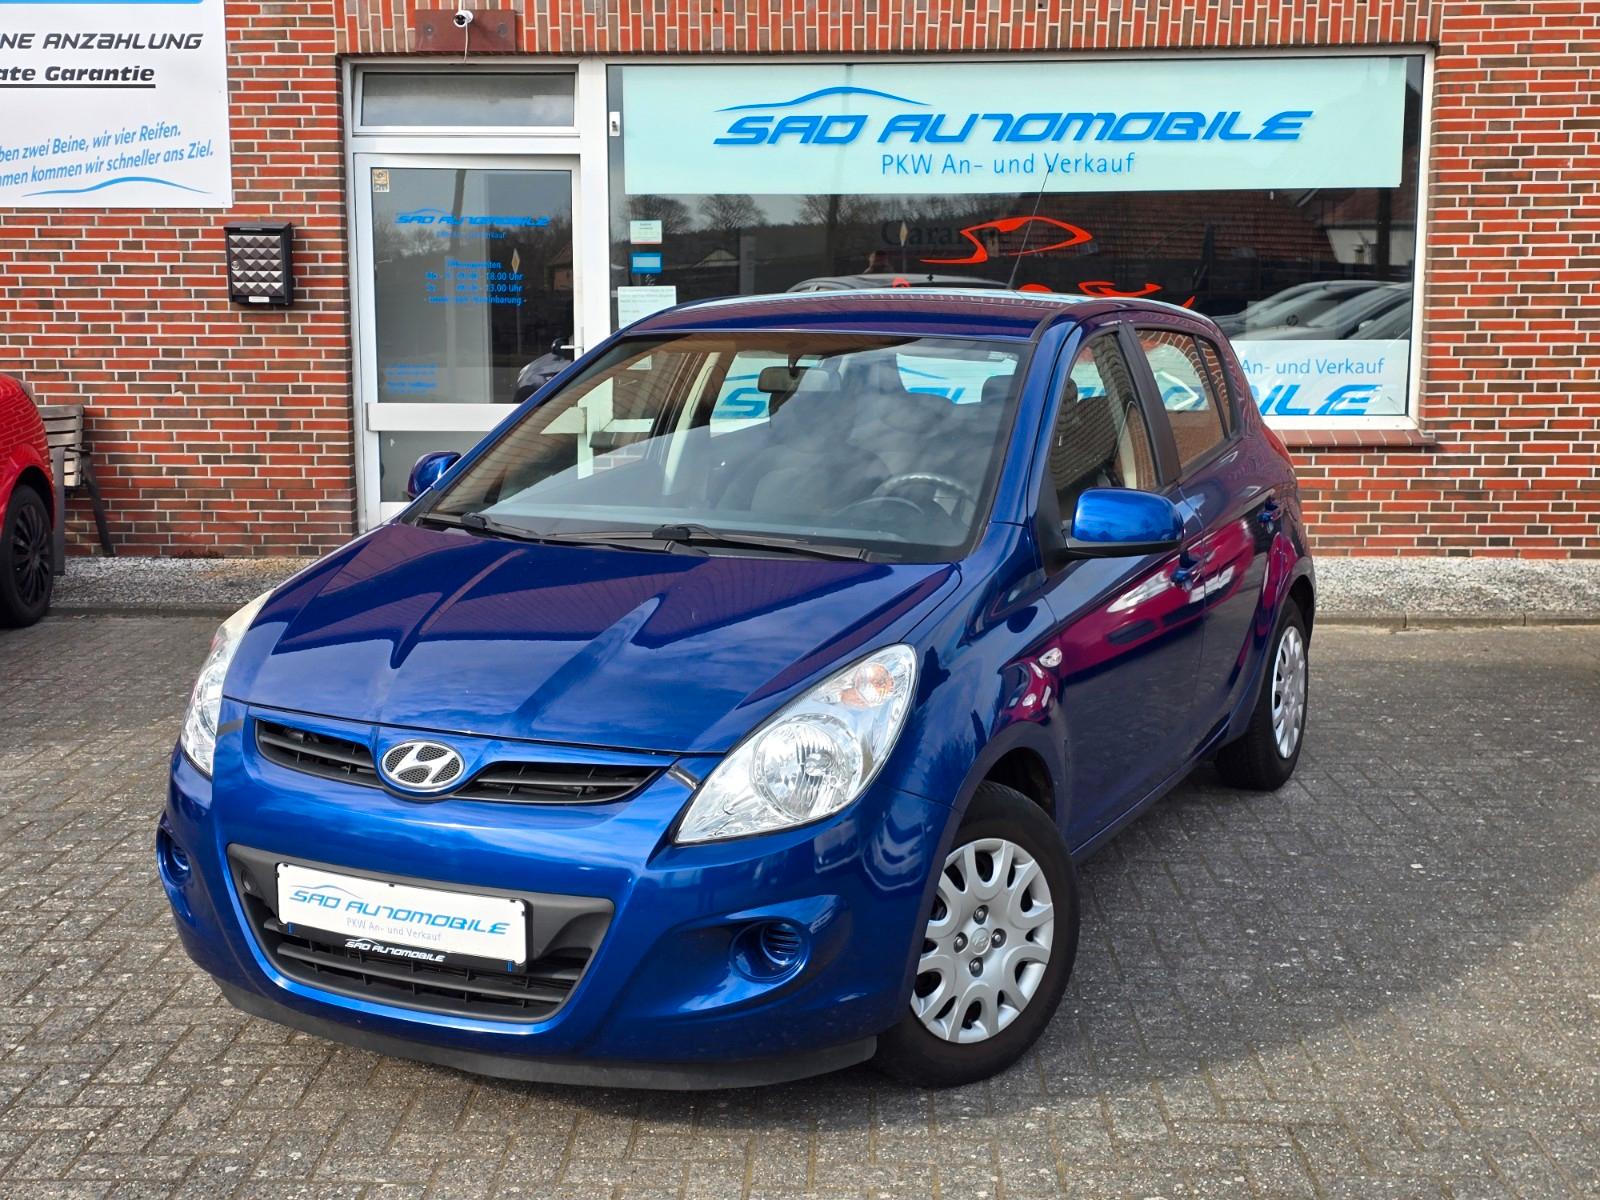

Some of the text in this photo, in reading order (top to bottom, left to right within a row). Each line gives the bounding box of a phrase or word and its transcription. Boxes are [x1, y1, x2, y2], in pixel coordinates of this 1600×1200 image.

[45, 65, 155, 82] Garantie
[713, 109, 1314, 145] SAD AUTOMOBILE
[22, 138, 51, 159] zwei
[52, 135, 89, 154] Beine,
[92, 129, 112, 149] wir
[114, 127, 136, 145] vier
[139, 121, 181, 142] Reifen.
[31, 165, 82, 182] kommen
[85, 156, 104, 174] wir
[106, 148, 161, 171] schneller
[163, 149, 184, 163] ans
[187, 139, 214, 159] Ziel.
[882, 152, 1136, 176] PKW An- und Verkauf
[1276, 358, 1310, 376] und
[1315, 357, 1386, 376] Verkauf
[289, 890, 511, 935] SAD AUTOMOBILE
[346, 917, 366, 929] PKW
[388, 926, 404, 936] und
[406, 928, 442, 942] Verkauf
[372, 944, 446, 962] AUTOMOBILE
